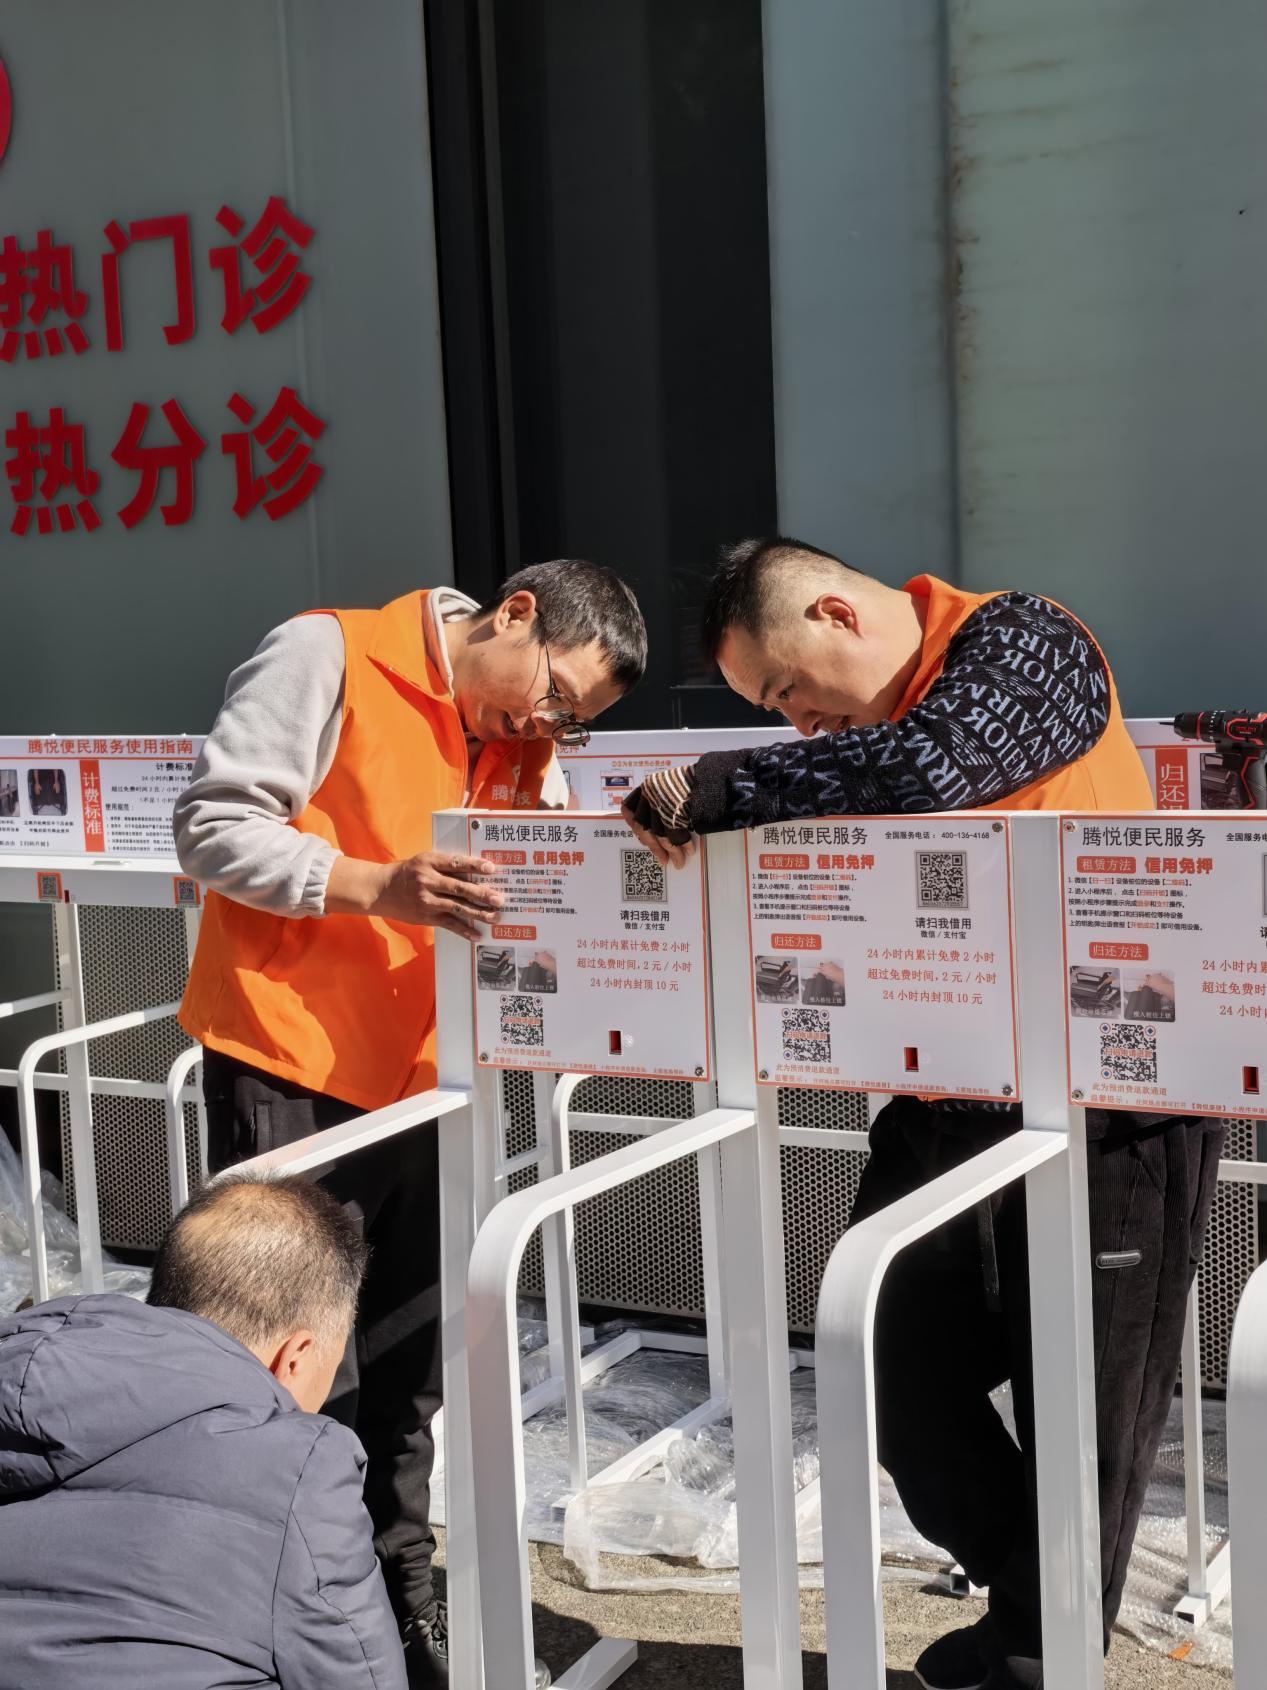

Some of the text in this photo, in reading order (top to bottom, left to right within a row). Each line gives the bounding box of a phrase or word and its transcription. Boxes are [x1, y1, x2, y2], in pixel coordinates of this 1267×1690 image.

[0, 196, 315, 364] 热门诊
[6, 386, 328, 537] 热分诊
[28, 739, 193, 754] 腾悦便民服务使用指南
[82, 773, 102, 834] 计费标准
[485, 825, 579, 843] 腾悦便民服务
[763, 826, 868, 845] 腾悦便民服务
[1082, 826, 1206, 847] 腾悦便民服务
[533, 850, 585, 866] 信用免押
[764, 856, 807, 868] 租赁方法
[816, 854, 875, 870] 信用免押
[1082, 858, 1132, 871] 租赁方法
[1145, 856, 1213, 874] 信用免押
[620, 910, 670, 922] 请扫我借用
[915, 917, 971, 930] 请扫我借用
[494, 925, 533, 939] 归还方法
[774, 935, 816, 949] 归还方法
[1093, 944, 1143, 959] 归还方法
